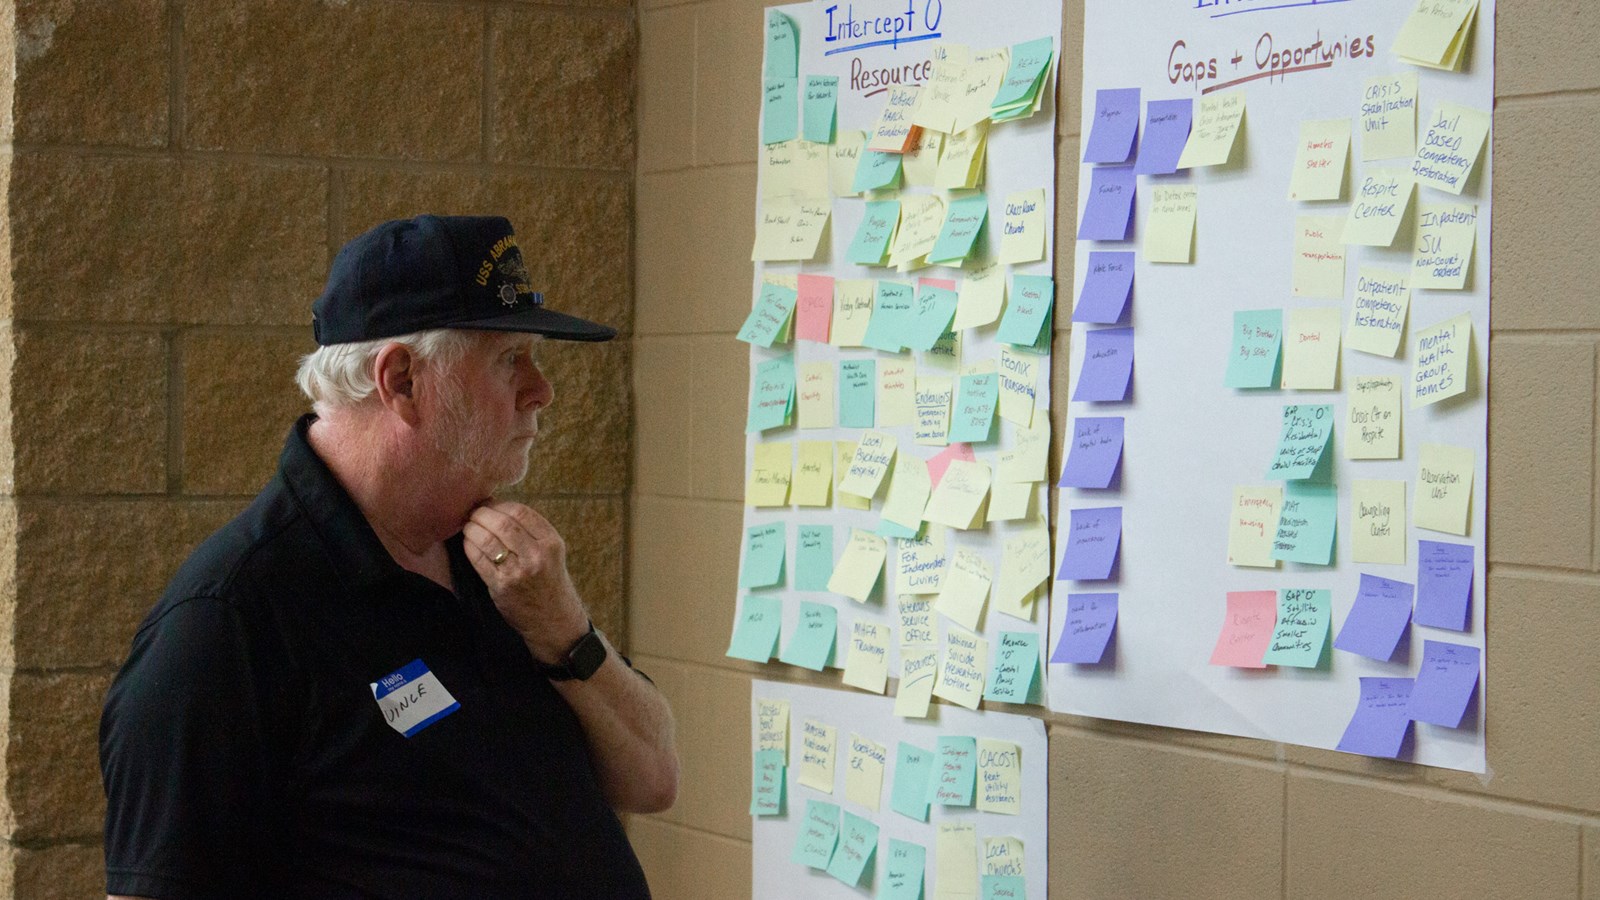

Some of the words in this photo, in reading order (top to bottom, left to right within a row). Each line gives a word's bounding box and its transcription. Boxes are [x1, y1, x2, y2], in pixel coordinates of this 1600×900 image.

[825, 0, 915, 50] Intercept
[1168, 39, 1218, 92] Gaps
[1255, 29, 1375, 85] Opportunies
[1433, 109, 1461, 132] Jail
[476, 260, 494, 286] USS
[490, 234, 518, 262] ABRAH
[382, 673, 404, 688] Hello
